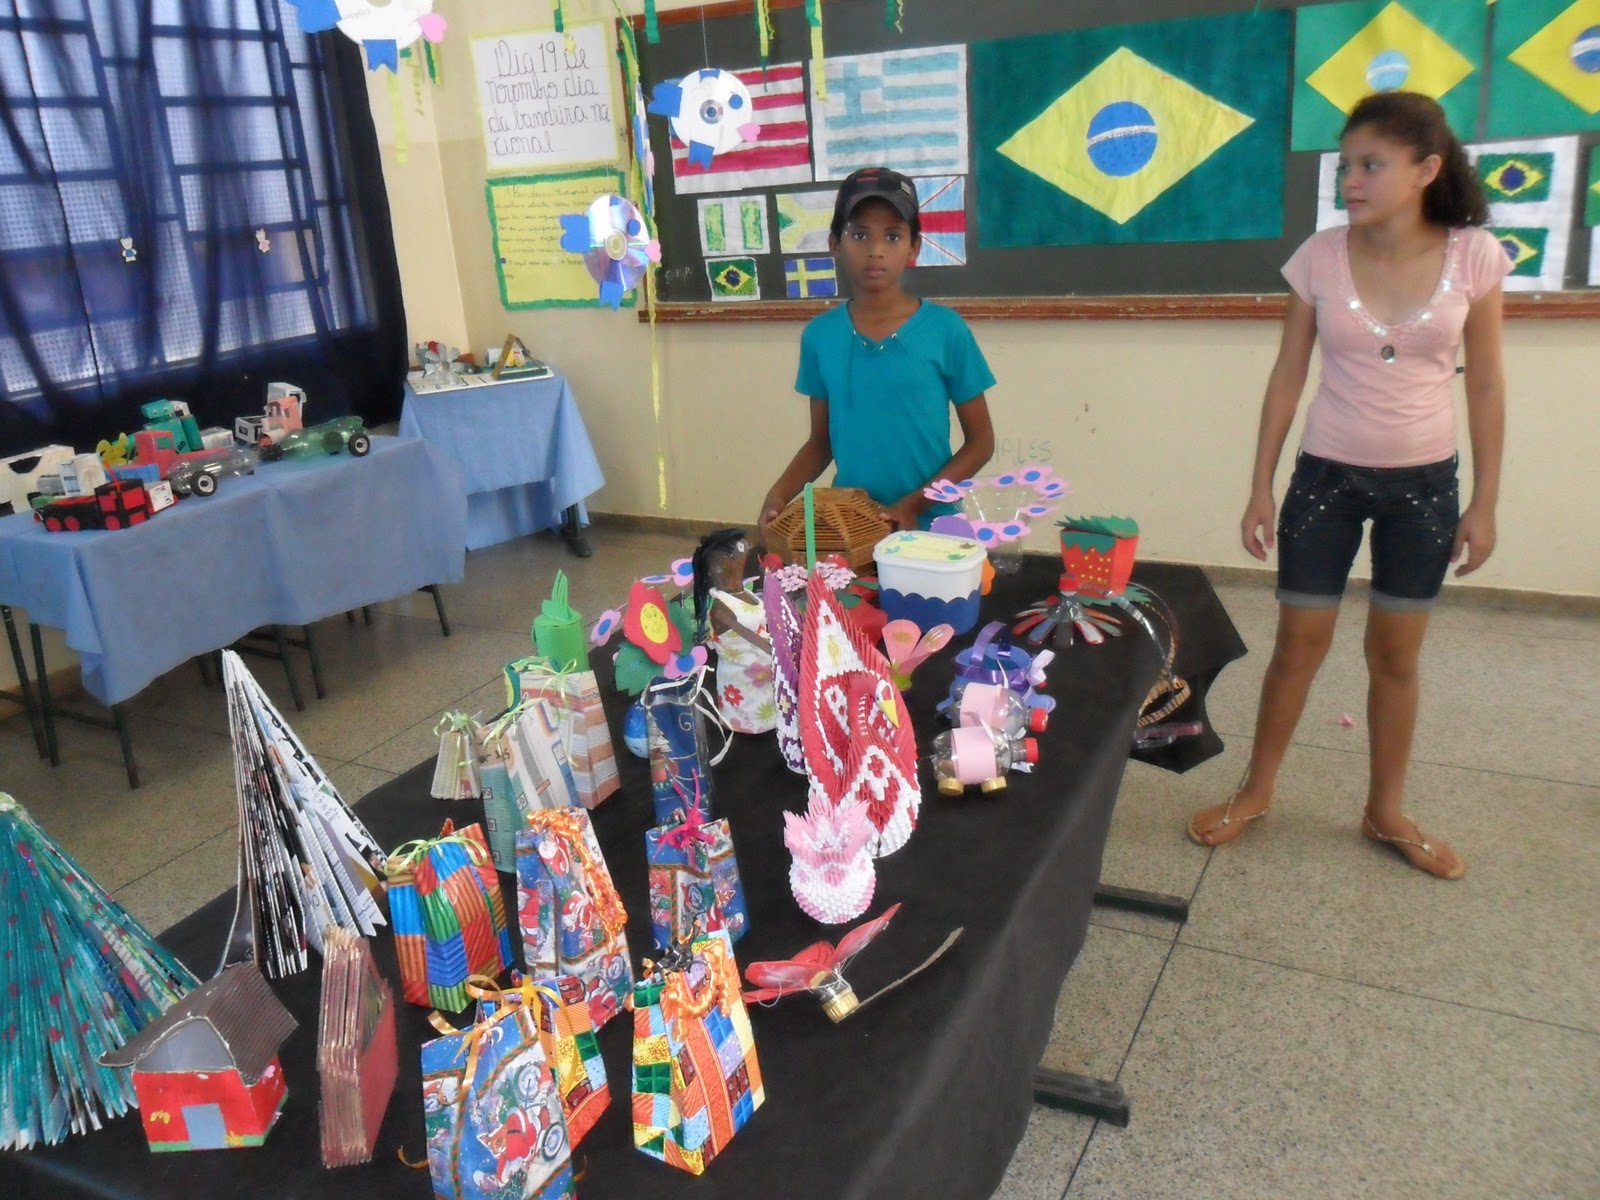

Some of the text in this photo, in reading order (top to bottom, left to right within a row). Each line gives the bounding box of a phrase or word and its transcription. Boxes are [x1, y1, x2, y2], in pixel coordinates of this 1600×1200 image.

[494, 39, 535, 78] Dia
[538, 41, 557, 72] 19
[564, 69, 599, 97] dia
[488, 101, 611, 133] da bandeira na
